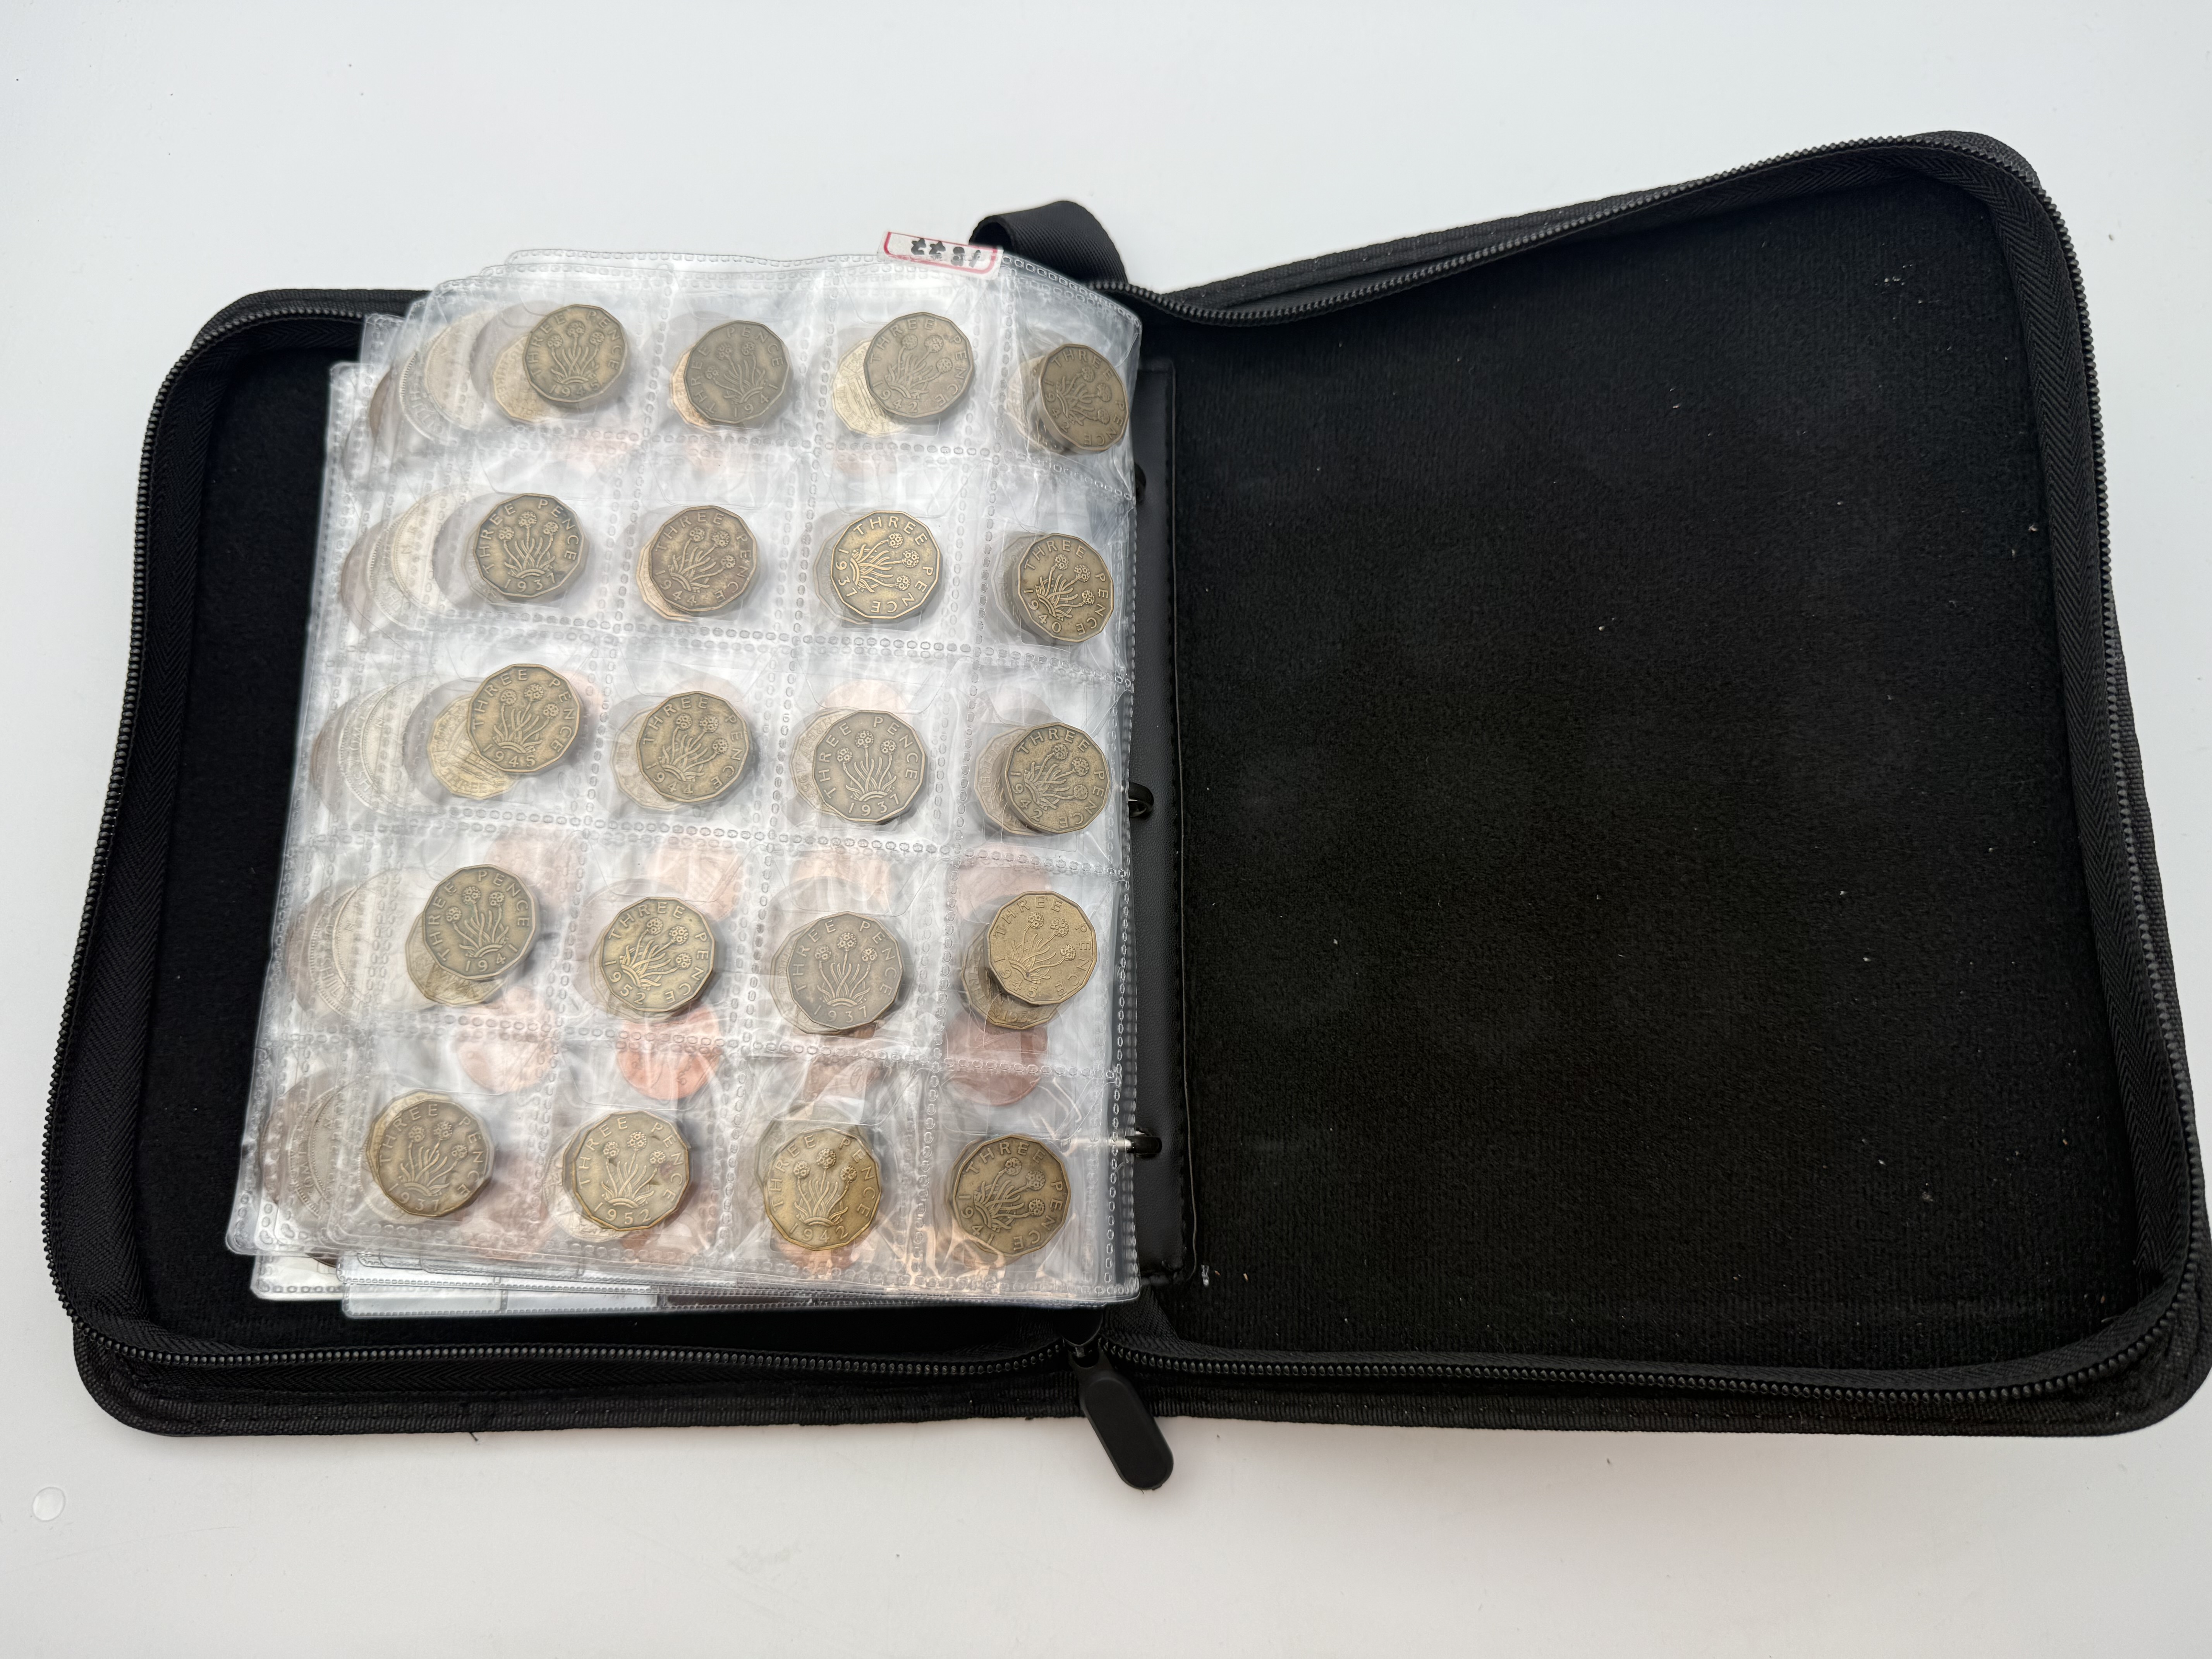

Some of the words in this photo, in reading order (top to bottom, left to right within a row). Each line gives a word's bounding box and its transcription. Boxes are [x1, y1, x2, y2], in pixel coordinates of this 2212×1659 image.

[528, 313, 567, 378] THREE
[586, 311, 623, 370] PENCE
[870, 318, 937, 363] THREE
[937, 335, 968, 406] PENCE
[549, 382, 599, 397] 1945
[690, 345, 716, 414] THREE
[726, 326, 785, 367] PENCE
[733, 384, 777, 418] 1941
[873, 381, 919, 413] 1942
[1045, 381, 1070, 433] 1942
[1052, 350, 1114, 380] THREE
[1084, 401, 1125, 447] PENCE
[480, 505, 516, 574] THREE
[539, 499, 579, 560] PENCE
[853, 516, 929, 546] THREE
[655, 512, 725, 552] THREE
[715, 534, 751, 603] PENCE
[837, 549, 858, 597] 1937
[504, 574, 556, 593] 1937
[656, 570, 697, 606] 1944
[871, 566, 934, 613] PENCE
[1025, 540, 1087, 570] THREE
[1076, 573, 1108, 635] PENCE
[1024, 589, 1062, 633] 1940
[474, 670, 528, 729] THREE
[550, 677, 575, 753] PENCE
[483, 744, 536, 767] 1945
[643, 697, 708, 744] THREE
[711, 715, 743, 789] PENCE
[818, 723, 851, 799] THREE
[873, 717, 919, 780] PENCE
[445, 773, 487, 793] THREE
[646, 761, 693, 795] 1944
[1010, 771, 1043, 821] 1942
[1017, 730, 1090, 753] THREE
[1059, 769, 1104, 829] PENCE
[848, 794, 900, 815] 1937
[431, 881, 457, 962] THREE
[477, 870, 529, 927] PENCE
[465, 946, 518, 972] 1941
[609, 902, 686, 939] THREE
[665, 931, 709, 1003] PENCE
[793, 920, 836, 996] THREE
[859, 920, 895, 996] PENCE
[993, 896, 1062, 937] THREE
[1055, 923, 1091, 997] PENCE
[604, 960, 644, 1004] 1952
[994, 957, 1036, 998] 1945
[812, 1005, 868, 1022] 1937
[380, 1104, 438, 1164] THREE
[458, 1117, 484, 1197] PENCE
[579, 1116, 627, 1187] THREE
[651, 1121, 683, 1200] PENCE
[391, 1183, 439, 1211] 1937
[770, 1134, 816, 1211] THREE
[839, 1136, 876, 1219] PENCE
[965, 1141, 1046, 1175] THREE
[1013, 1180, 1063, 1250] PENCE
[594, 1202, 651, 1224] 1952
[788, 1222, 848, 1242] 1942
[962, 1194, 994, 1244] 1941
